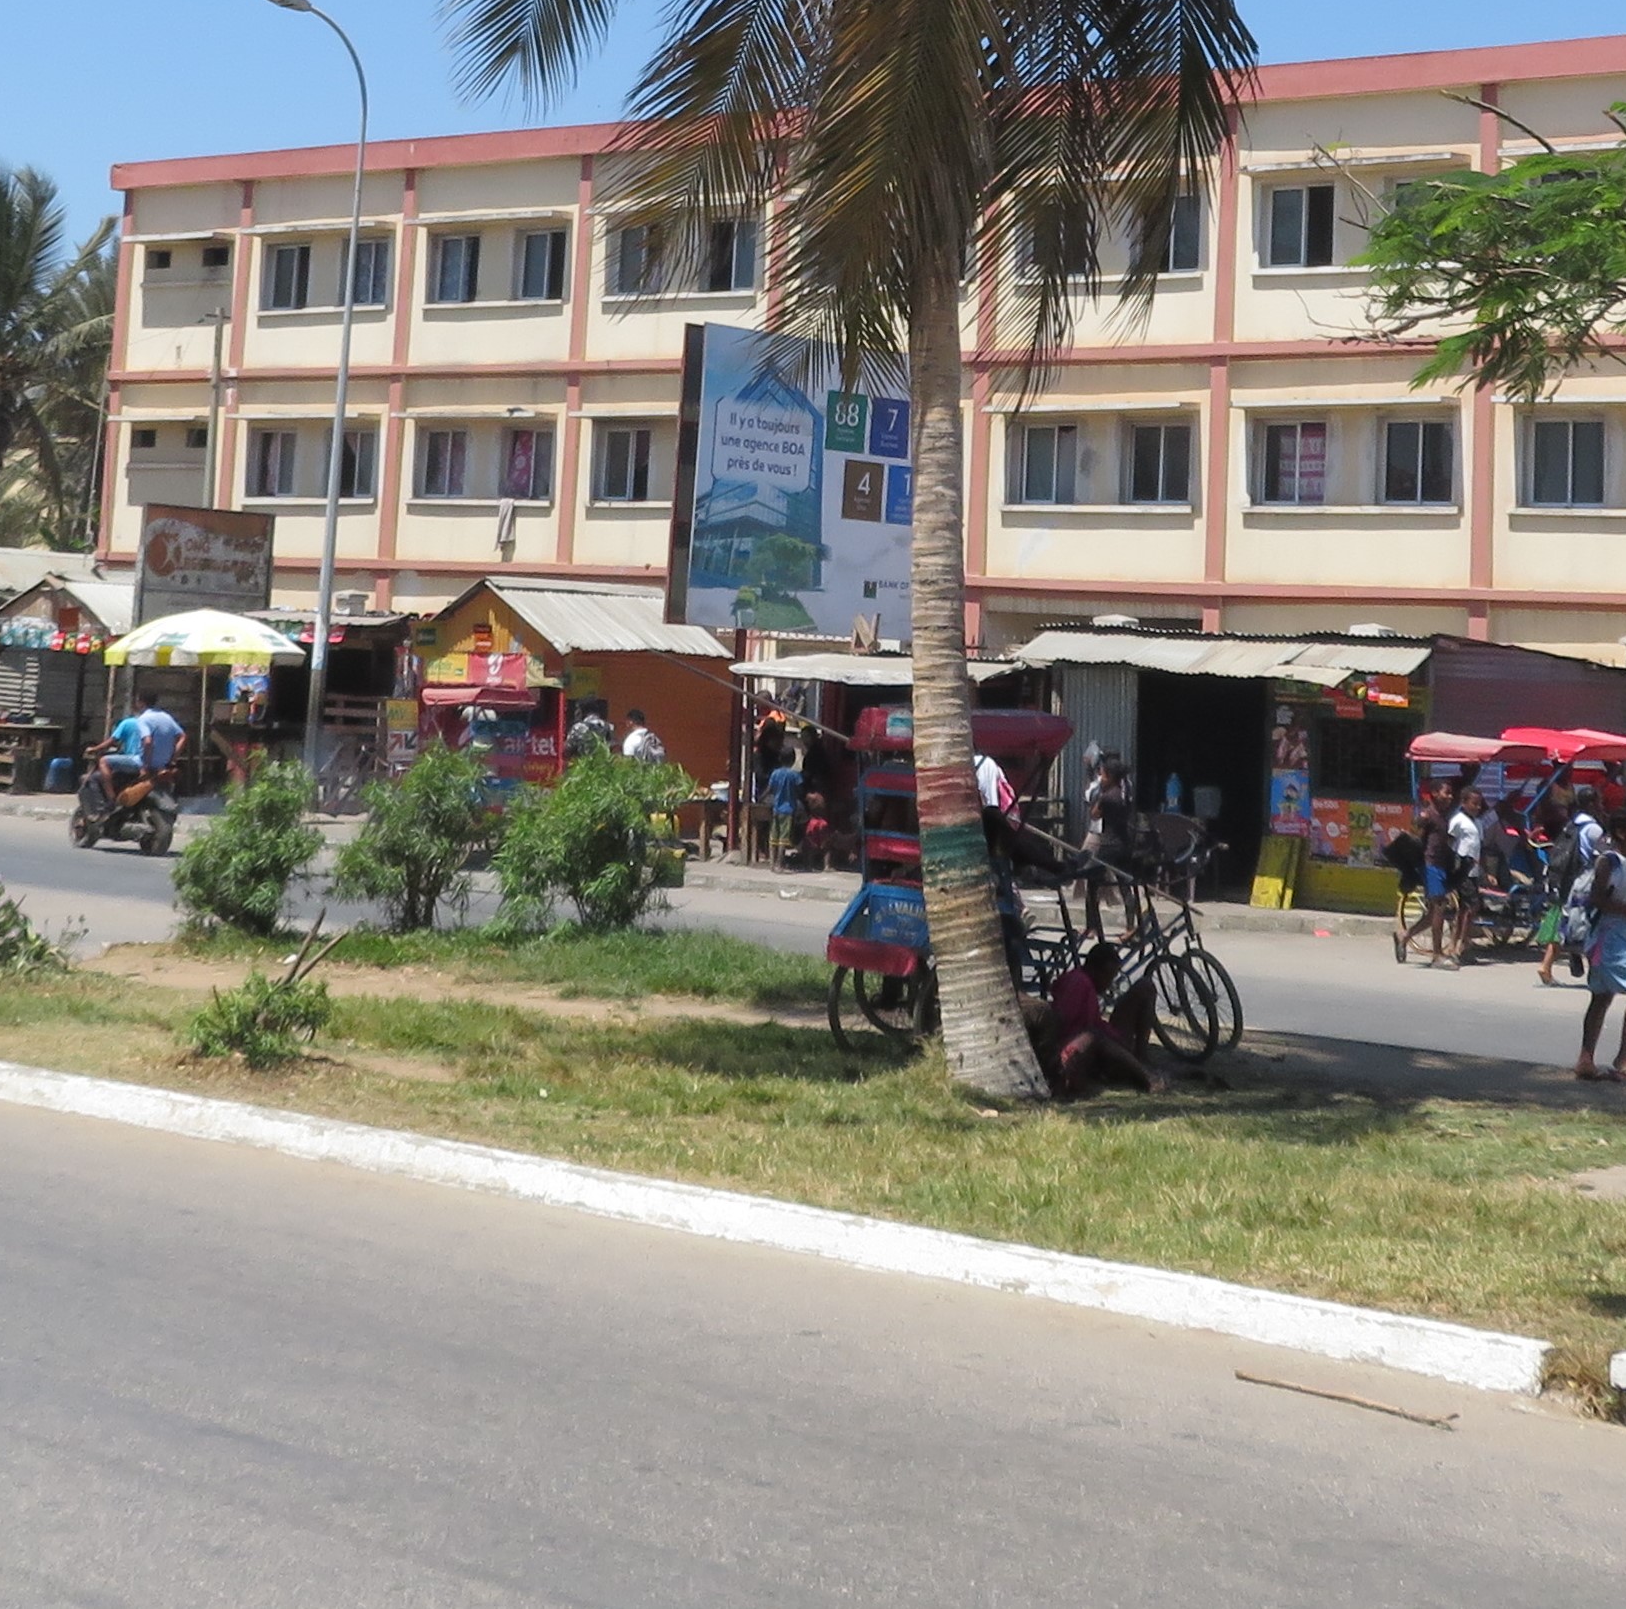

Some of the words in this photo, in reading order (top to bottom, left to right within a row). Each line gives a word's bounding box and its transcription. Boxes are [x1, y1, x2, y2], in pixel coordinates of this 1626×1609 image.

[730, 412, 737, 425] Il
[739, 417, 746, 430] y
[747, 419, 754, 429] a
[757, 417, 800, 436] toujours
[888, 408, 899, 432] 7
[721, 435, 741, 448] une
[743, 438, 779, 453] agence
[782, 441, 805, 456] BOA
[727, 456, 750, 471] près
[752, 458, 765, 471] de
[767, 464, 791, 476] vous
[858, 472, 871, 495] 4
[904, 473, 911, 496] 1
[878, 580, 898, 589] BANK
[504, 734, 557, 756] airtel
